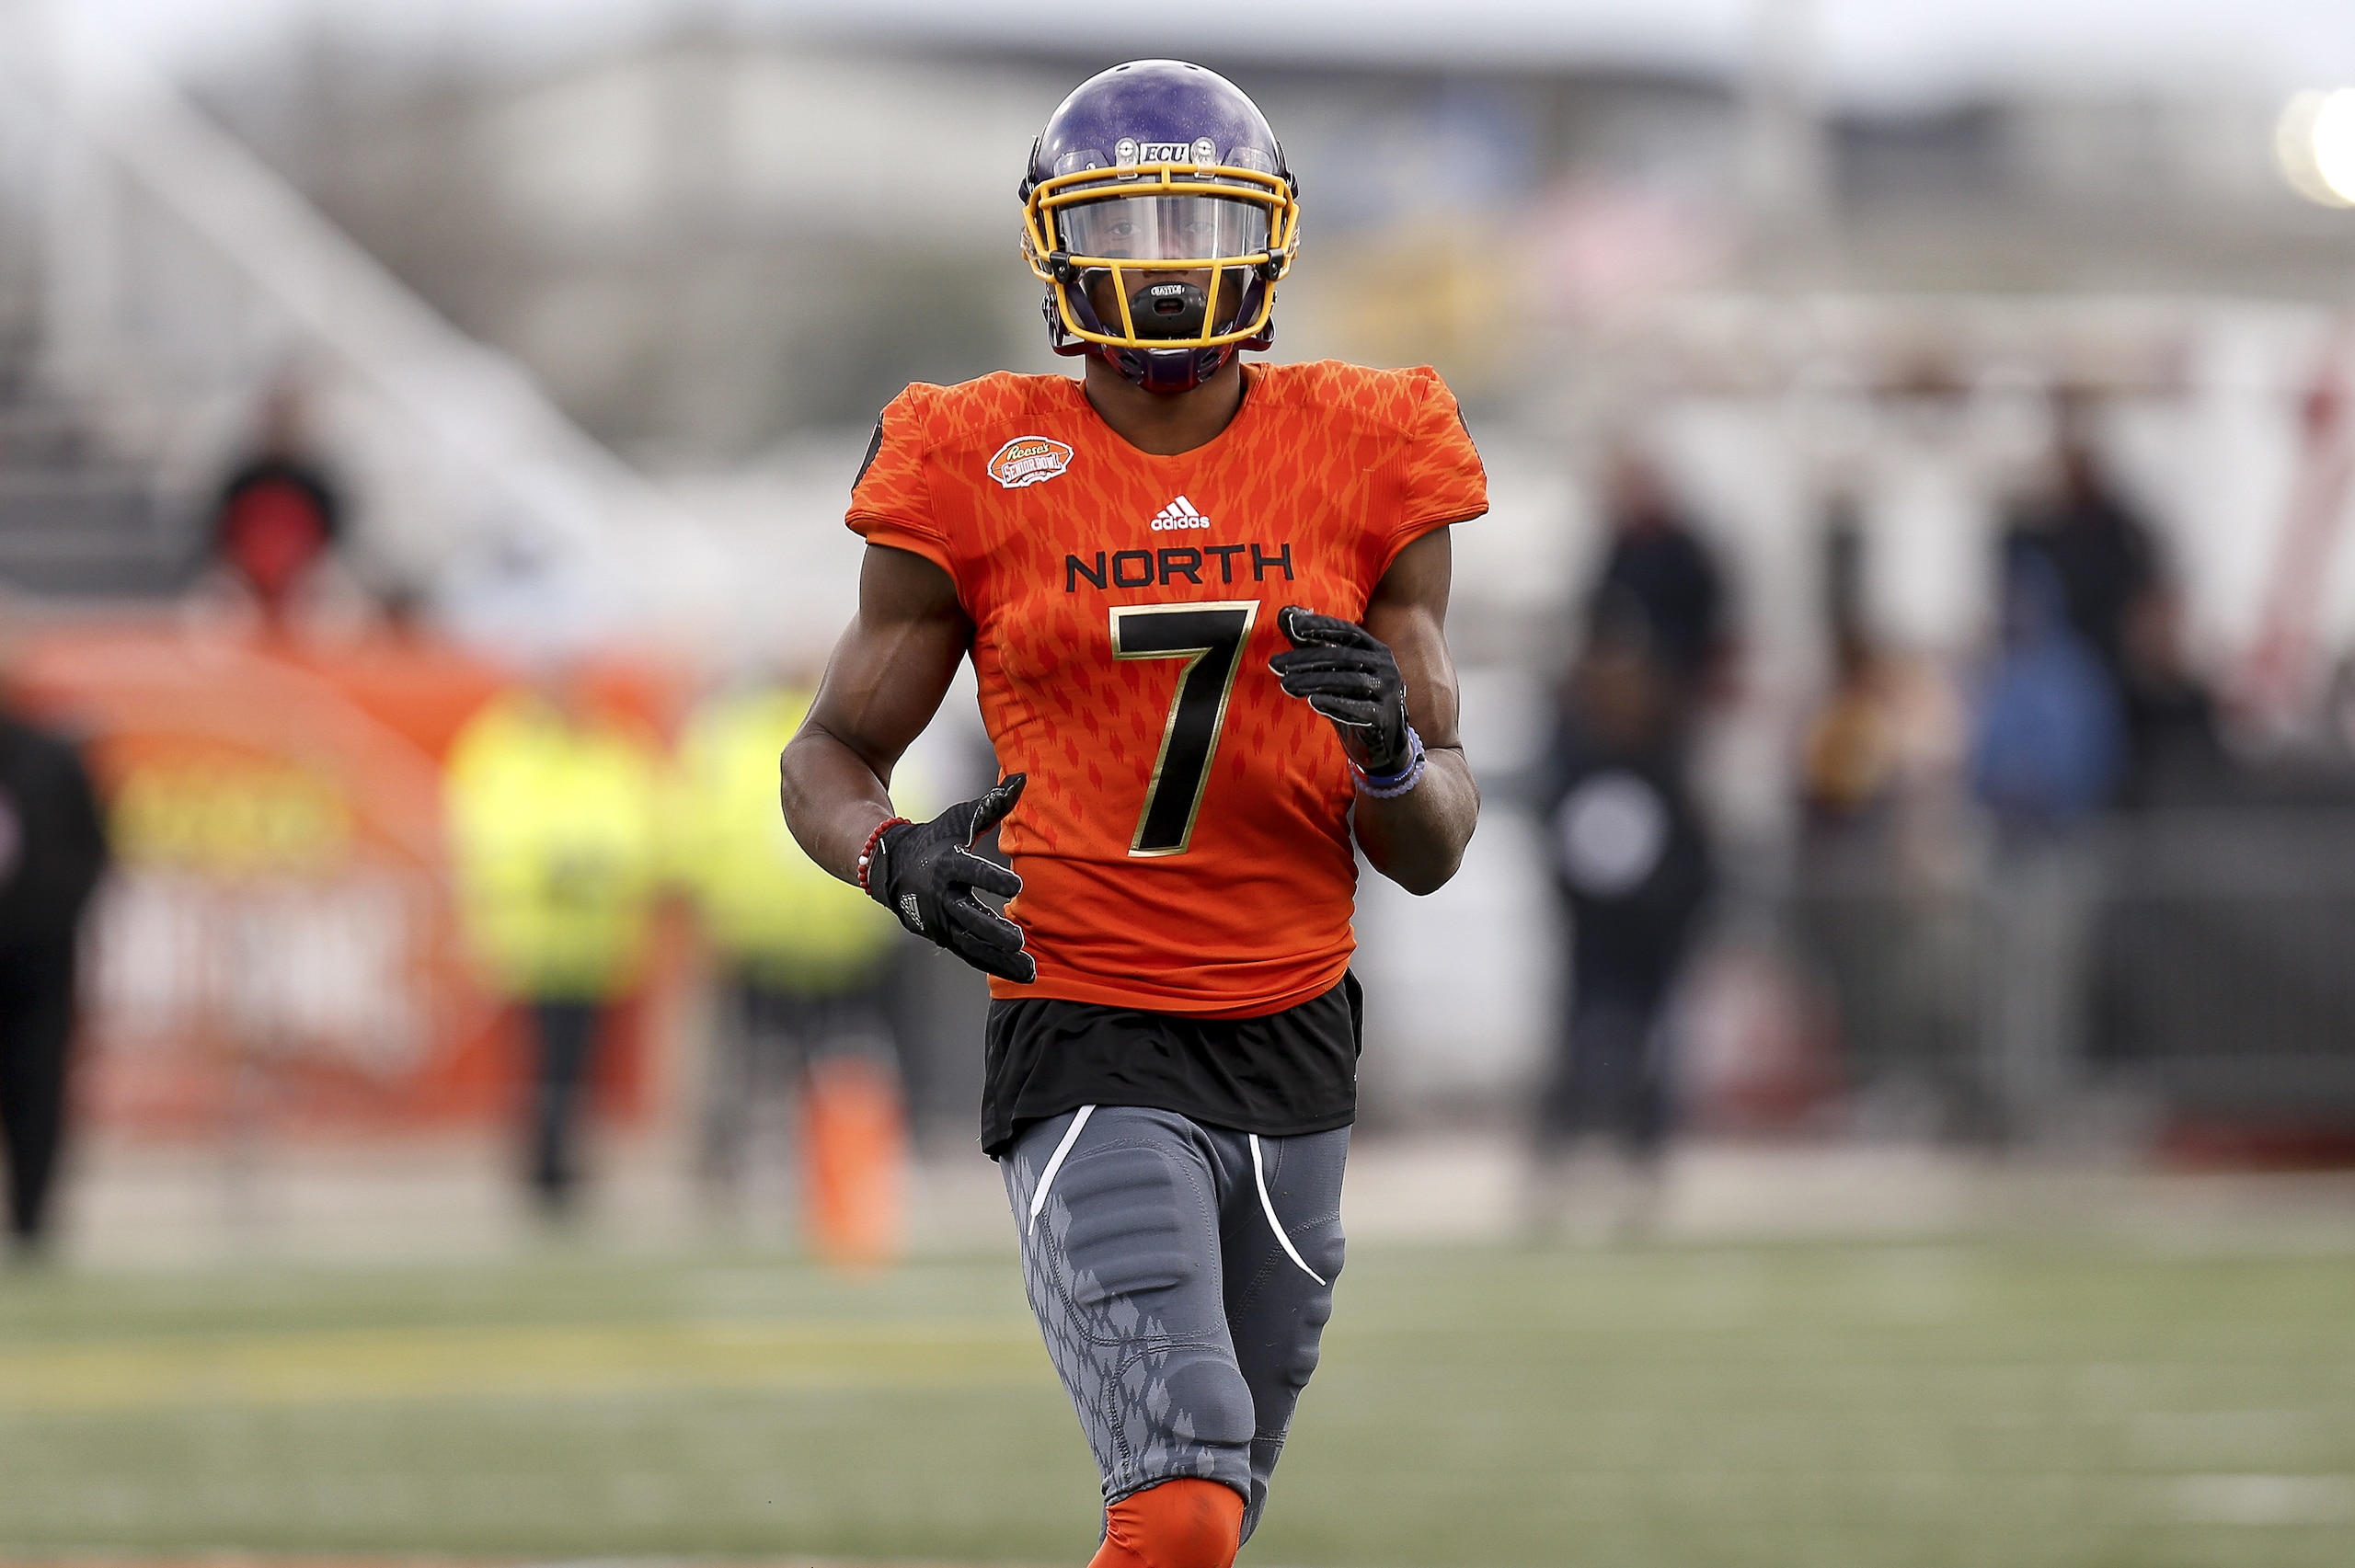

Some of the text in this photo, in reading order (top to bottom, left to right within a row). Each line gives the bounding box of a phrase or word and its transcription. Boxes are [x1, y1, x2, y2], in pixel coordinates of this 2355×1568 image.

[1143, 145, 1186, 162] ECU
[1006, 442, 1050, 461] Reese's
[1004, 459, 1036, 483] SENIOR
[1036, 453, 1063, 471] BOWL
[1150, 515, 1211, 532] adidas
[1065, 544, 1294, 592] NORTH
[1109, 600, 1261, 858] 7
